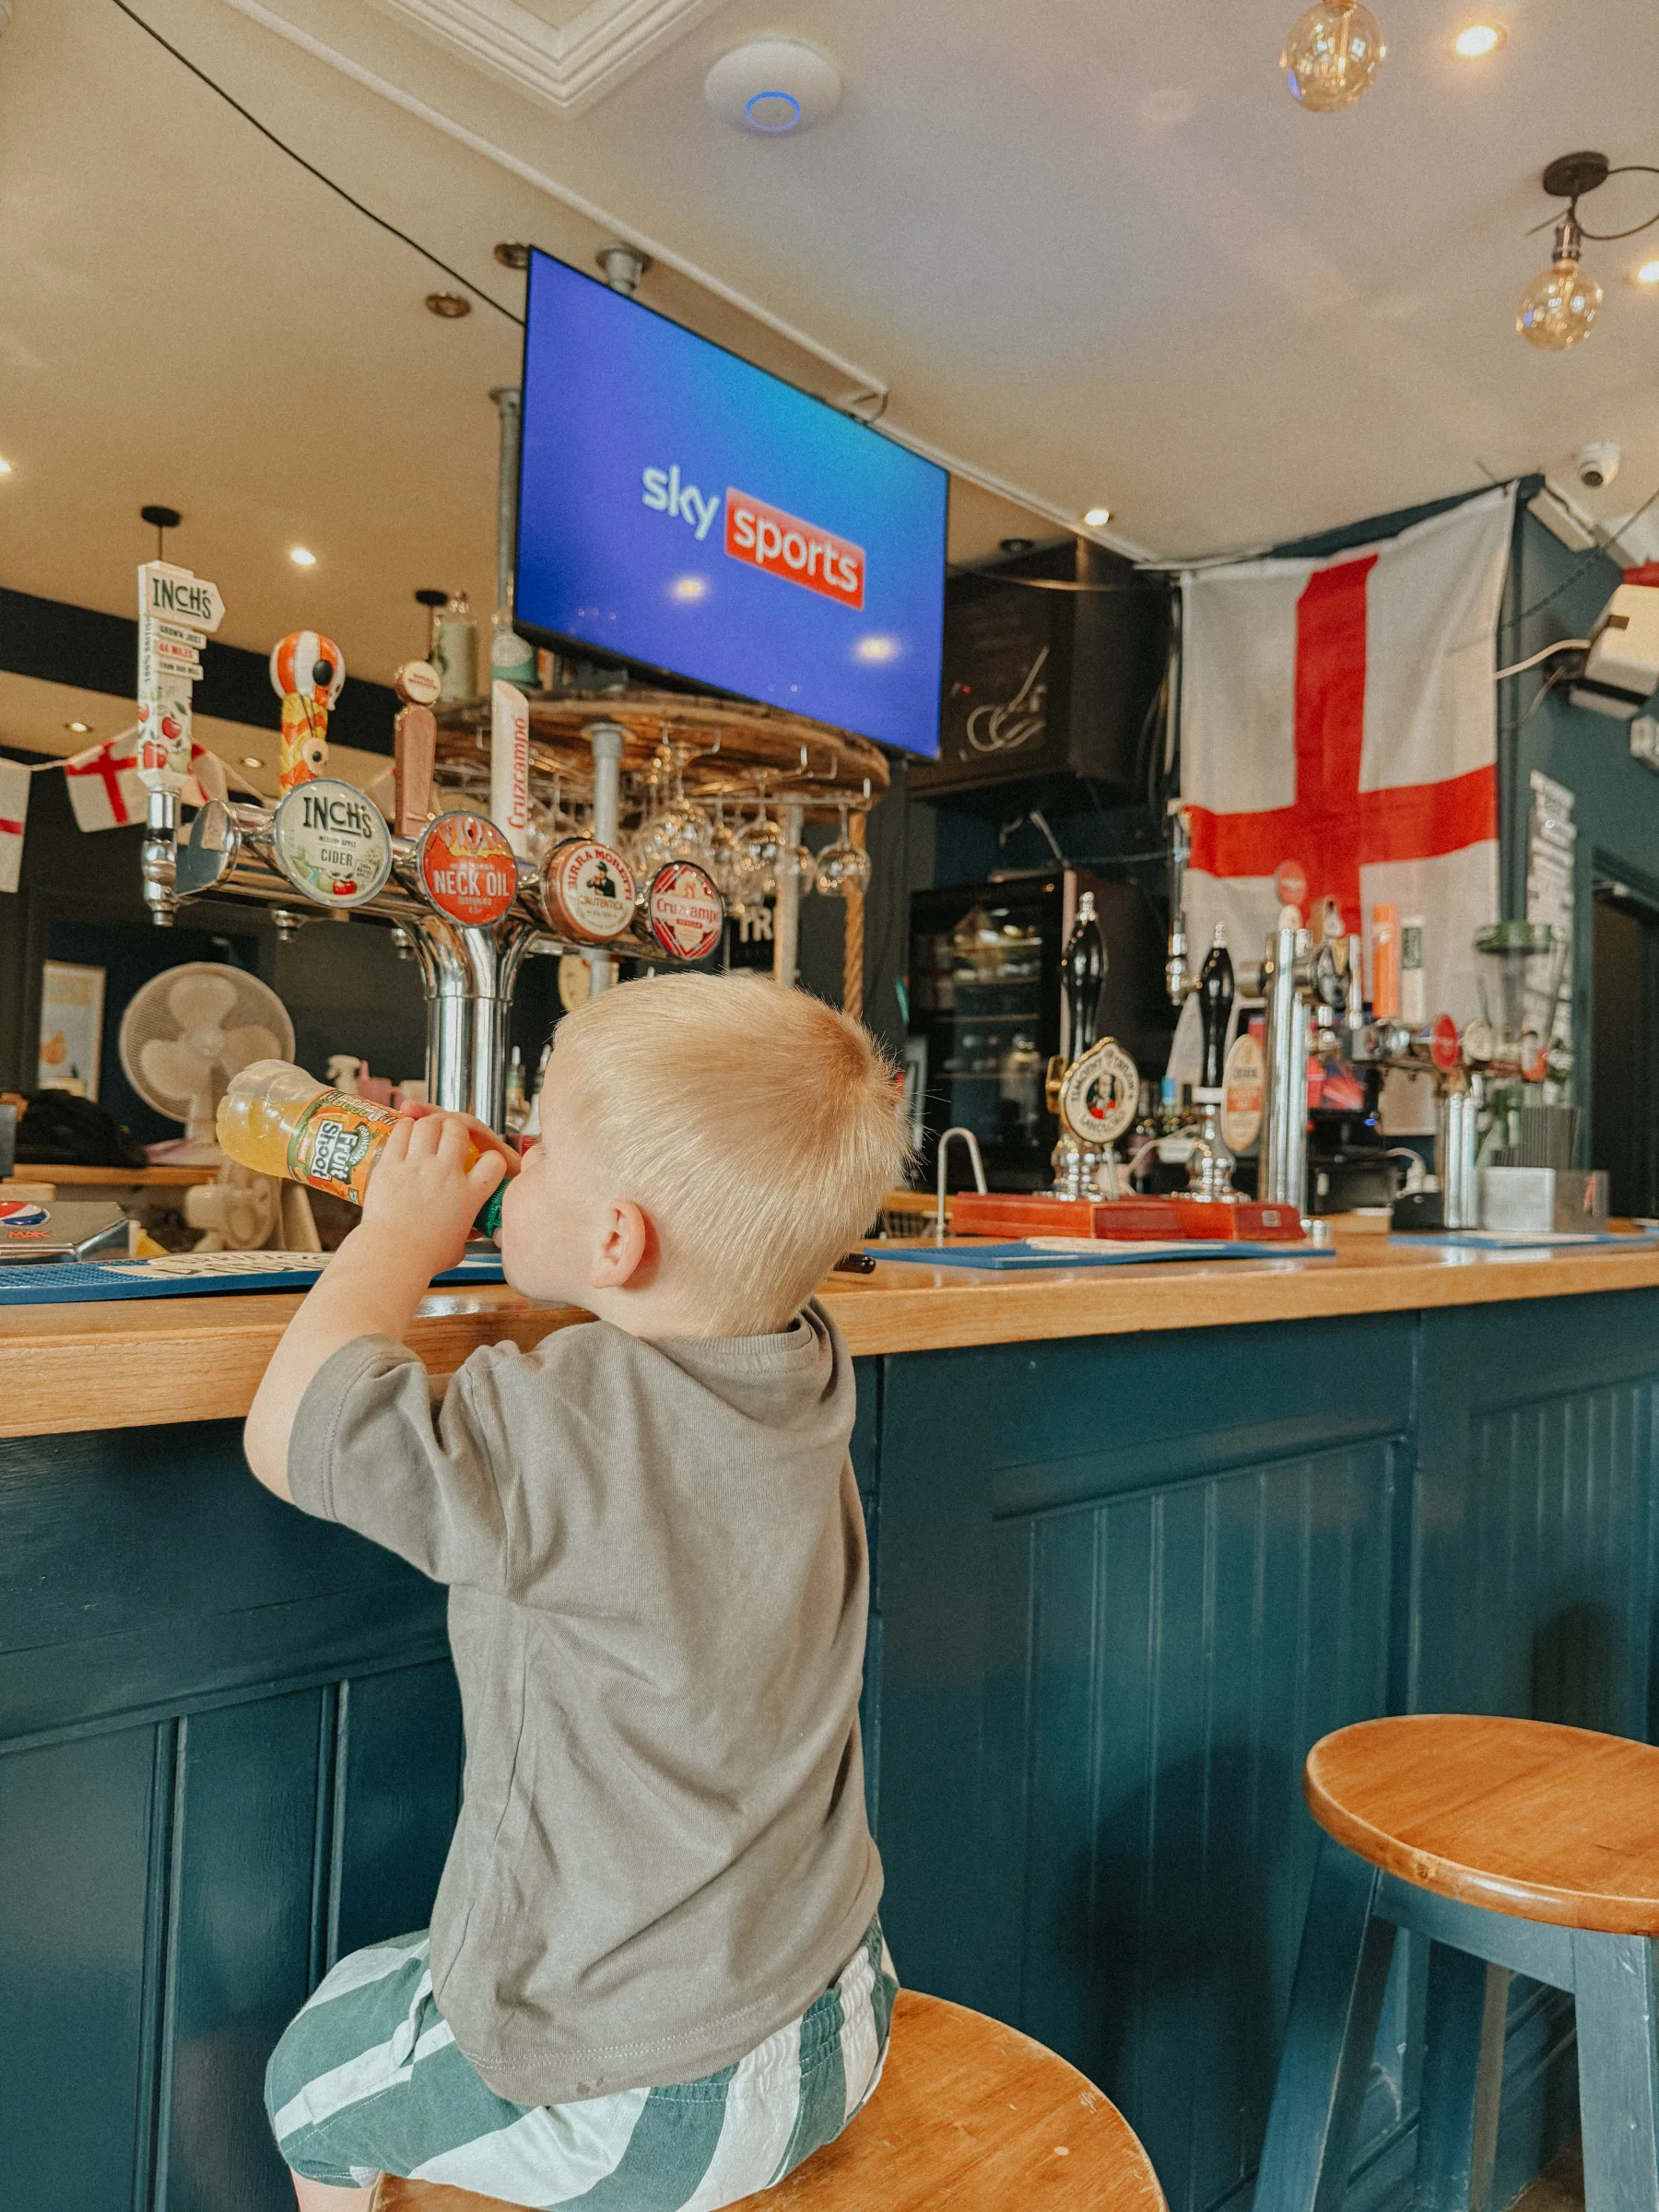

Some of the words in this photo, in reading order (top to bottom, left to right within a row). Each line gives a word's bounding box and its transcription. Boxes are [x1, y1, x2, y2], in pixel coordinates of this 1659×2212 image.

[642, 465, 721, 541] sky
[733, 508, 858, 593] sports
[508, 717, 528, 829] Cruzcampo
[321, 848, 353, 866] CIDER
[433, 869, 480, 896] NECK
[486, 871, 510, 897] OIL
[312, 1122, 340, 1177] Shoot
[331, 1131, 359, 1179] Fruit
[350, 1124, 371, 1165] ROBINSONS
[7, 1230, 52, 1242] MAX
